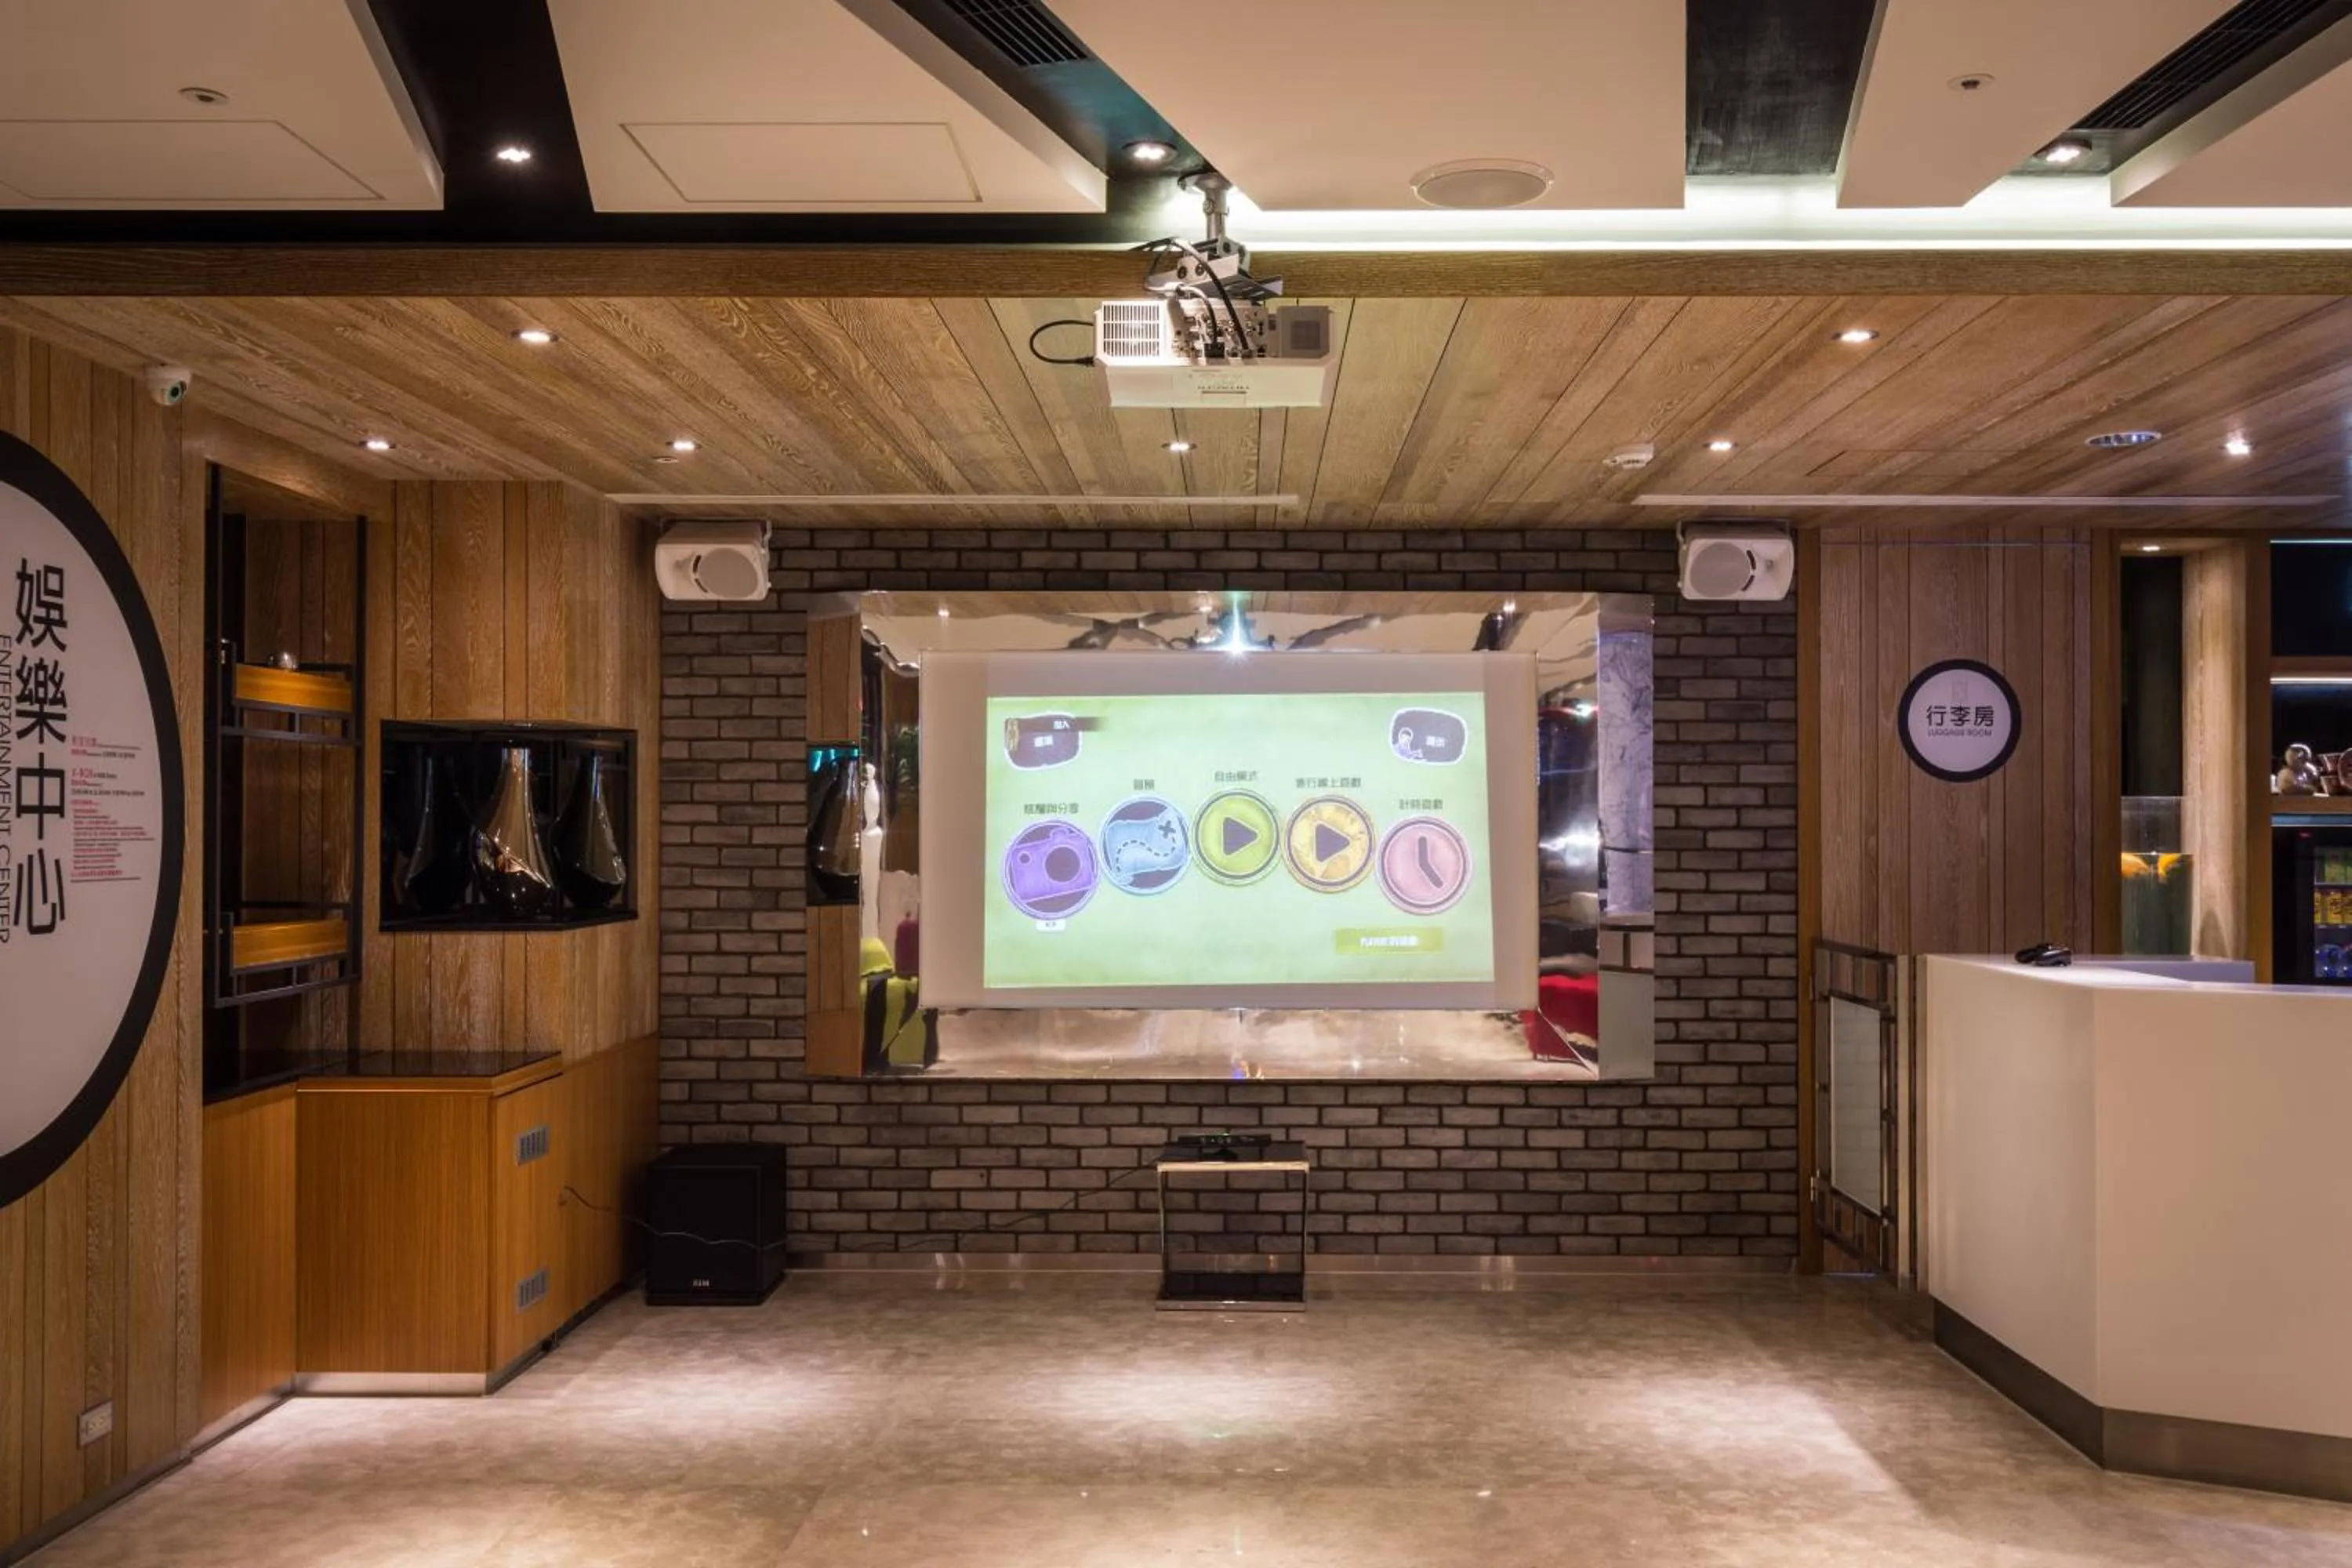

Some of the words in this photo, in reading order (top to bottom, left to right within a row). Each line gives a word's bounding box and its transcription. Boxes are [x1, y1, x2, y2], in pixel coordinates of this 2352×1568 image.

[0, 634, 12, 836] ENTERTAINMENT
[13, 557, 68, 935] 娛樂中心
[1926, 705, 1994, 727] 行李房
